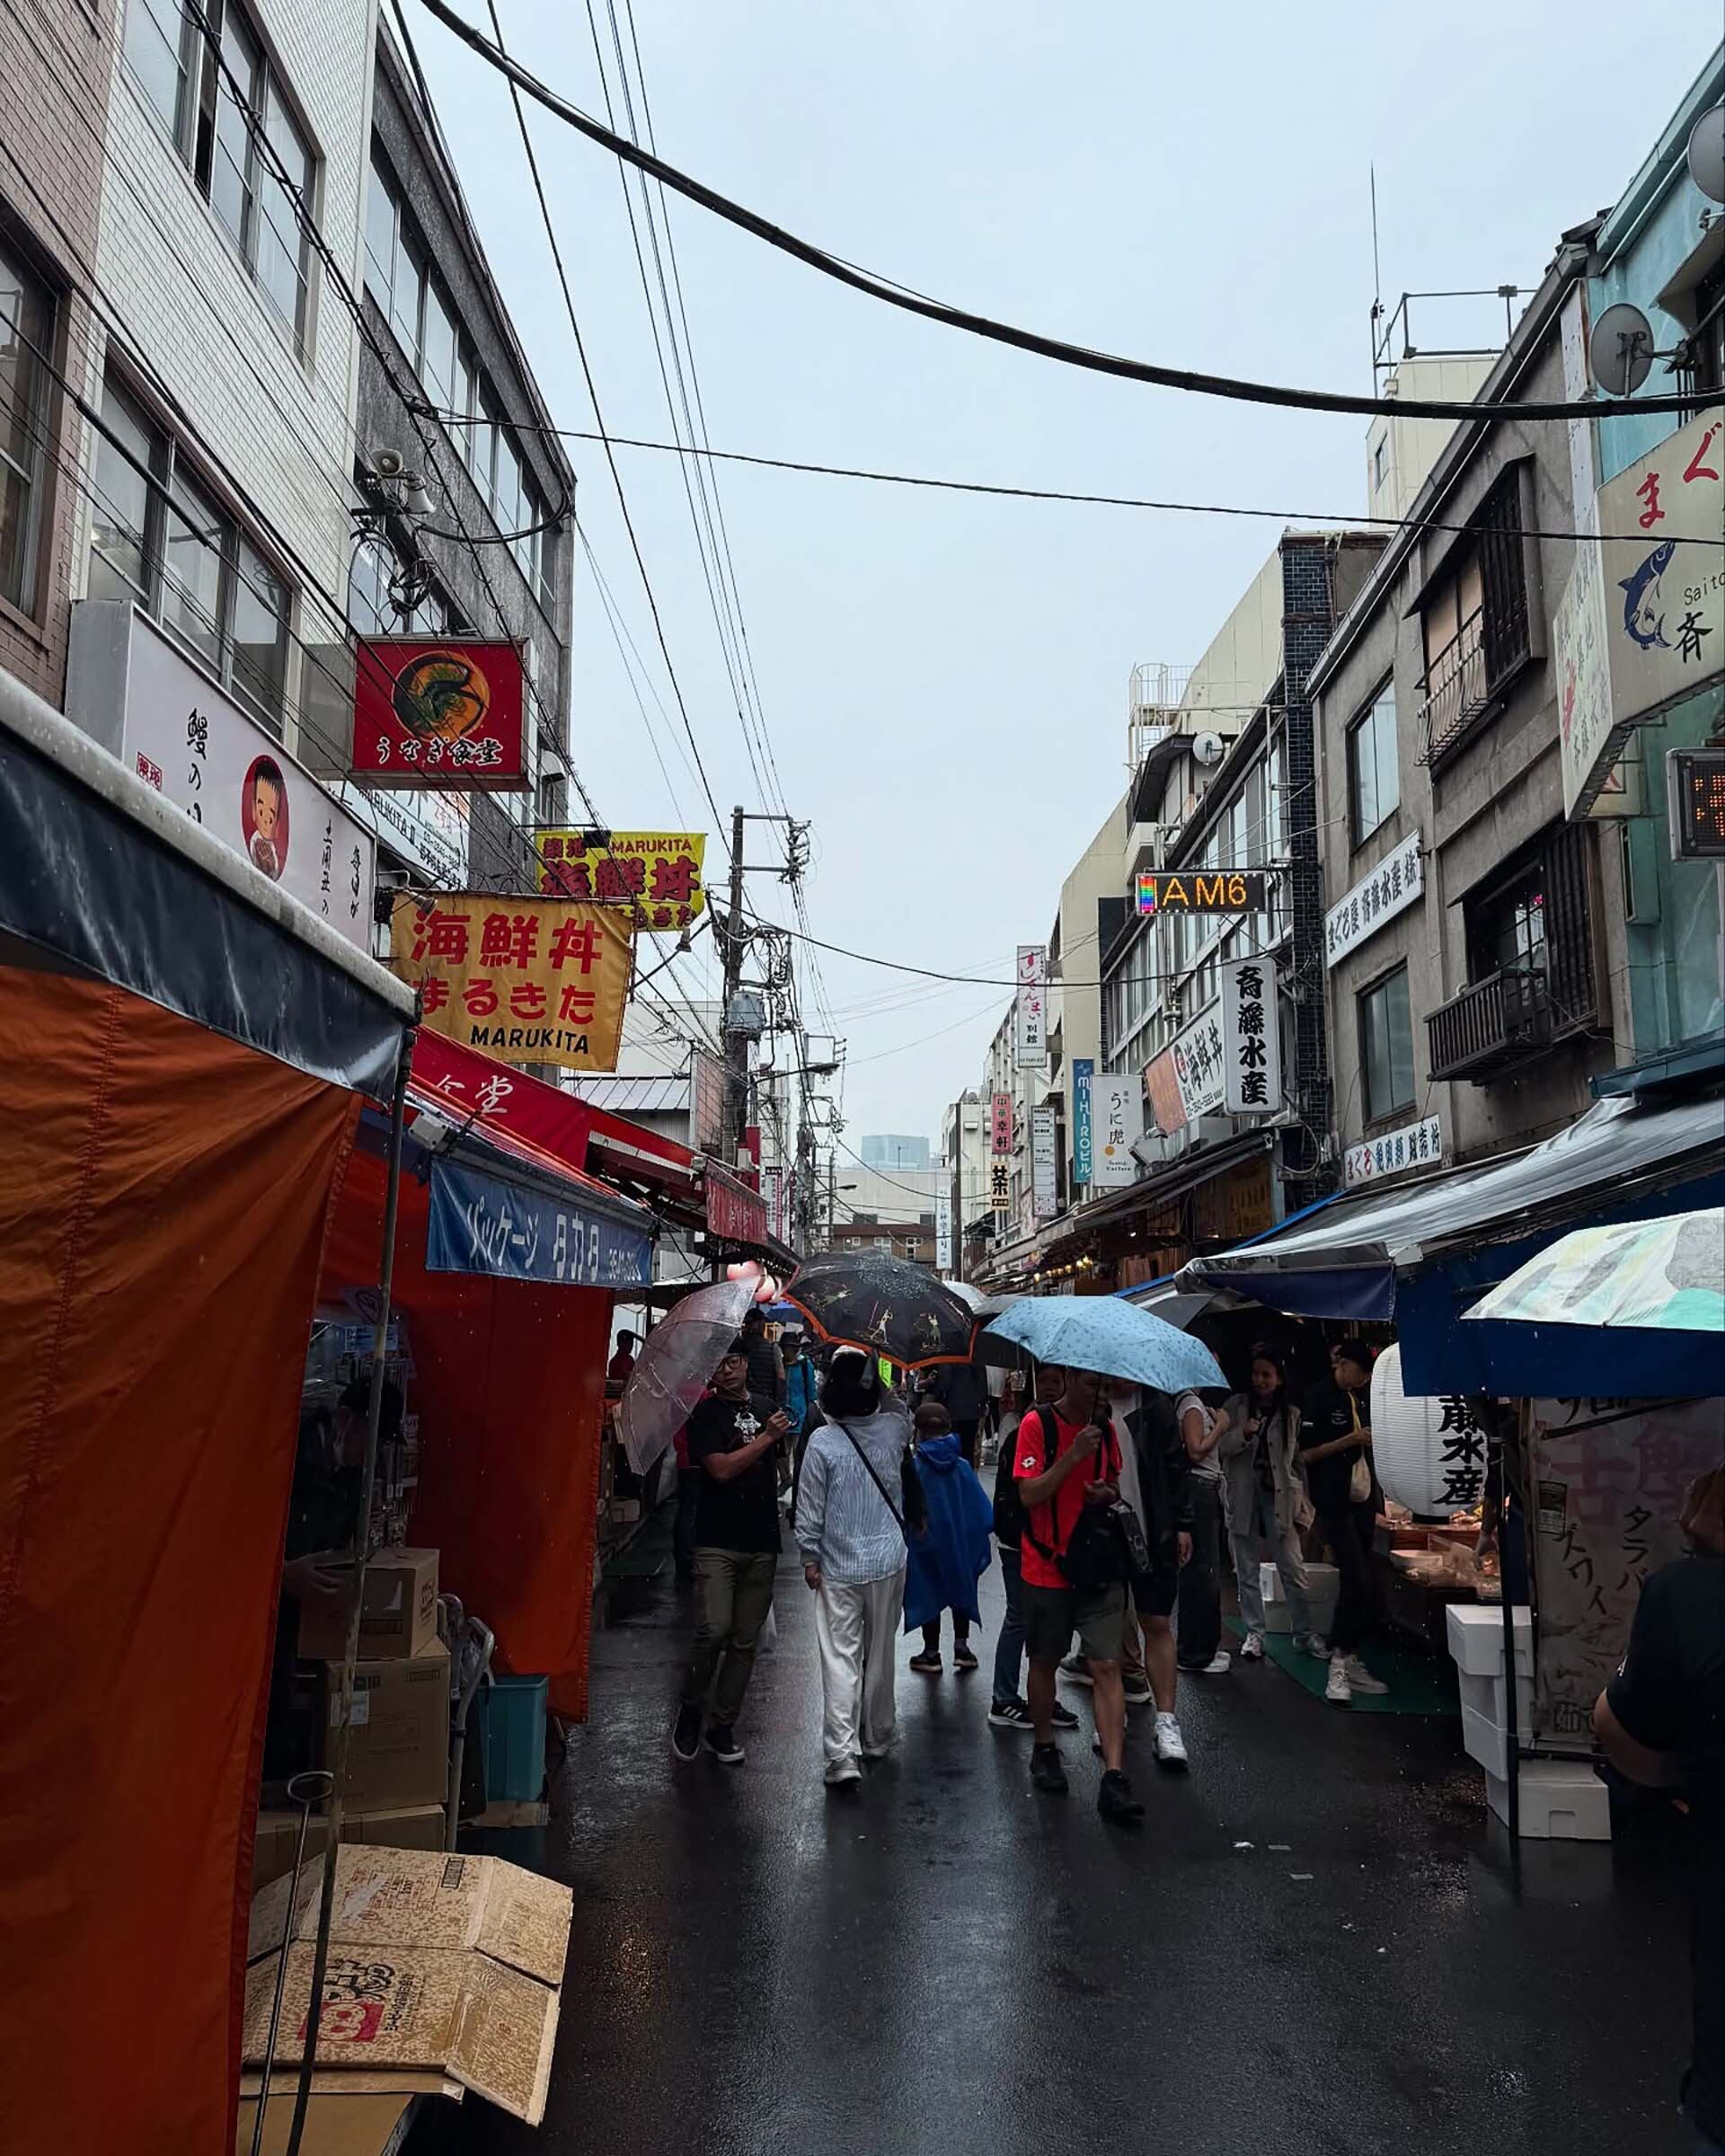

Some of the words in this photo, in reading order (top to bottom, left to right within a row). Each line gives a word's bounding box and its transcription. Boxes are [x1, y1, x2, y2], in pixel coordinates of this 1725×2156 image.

[376, 737, 503, 766] うなぎ食堂
[612, 839, 693, 853] MARUKITA
[541, 854, 700, 904] 海鮮丼
[411, 910, 604, 975] 海鮮丼
[409, 978, 596, 1025] まるきた
[470, 1025, 589, 1055] MARUKITA
[1109, 1092, 1124, 1144] うに虎
[992, 1165, 1008, 1197] 茶
